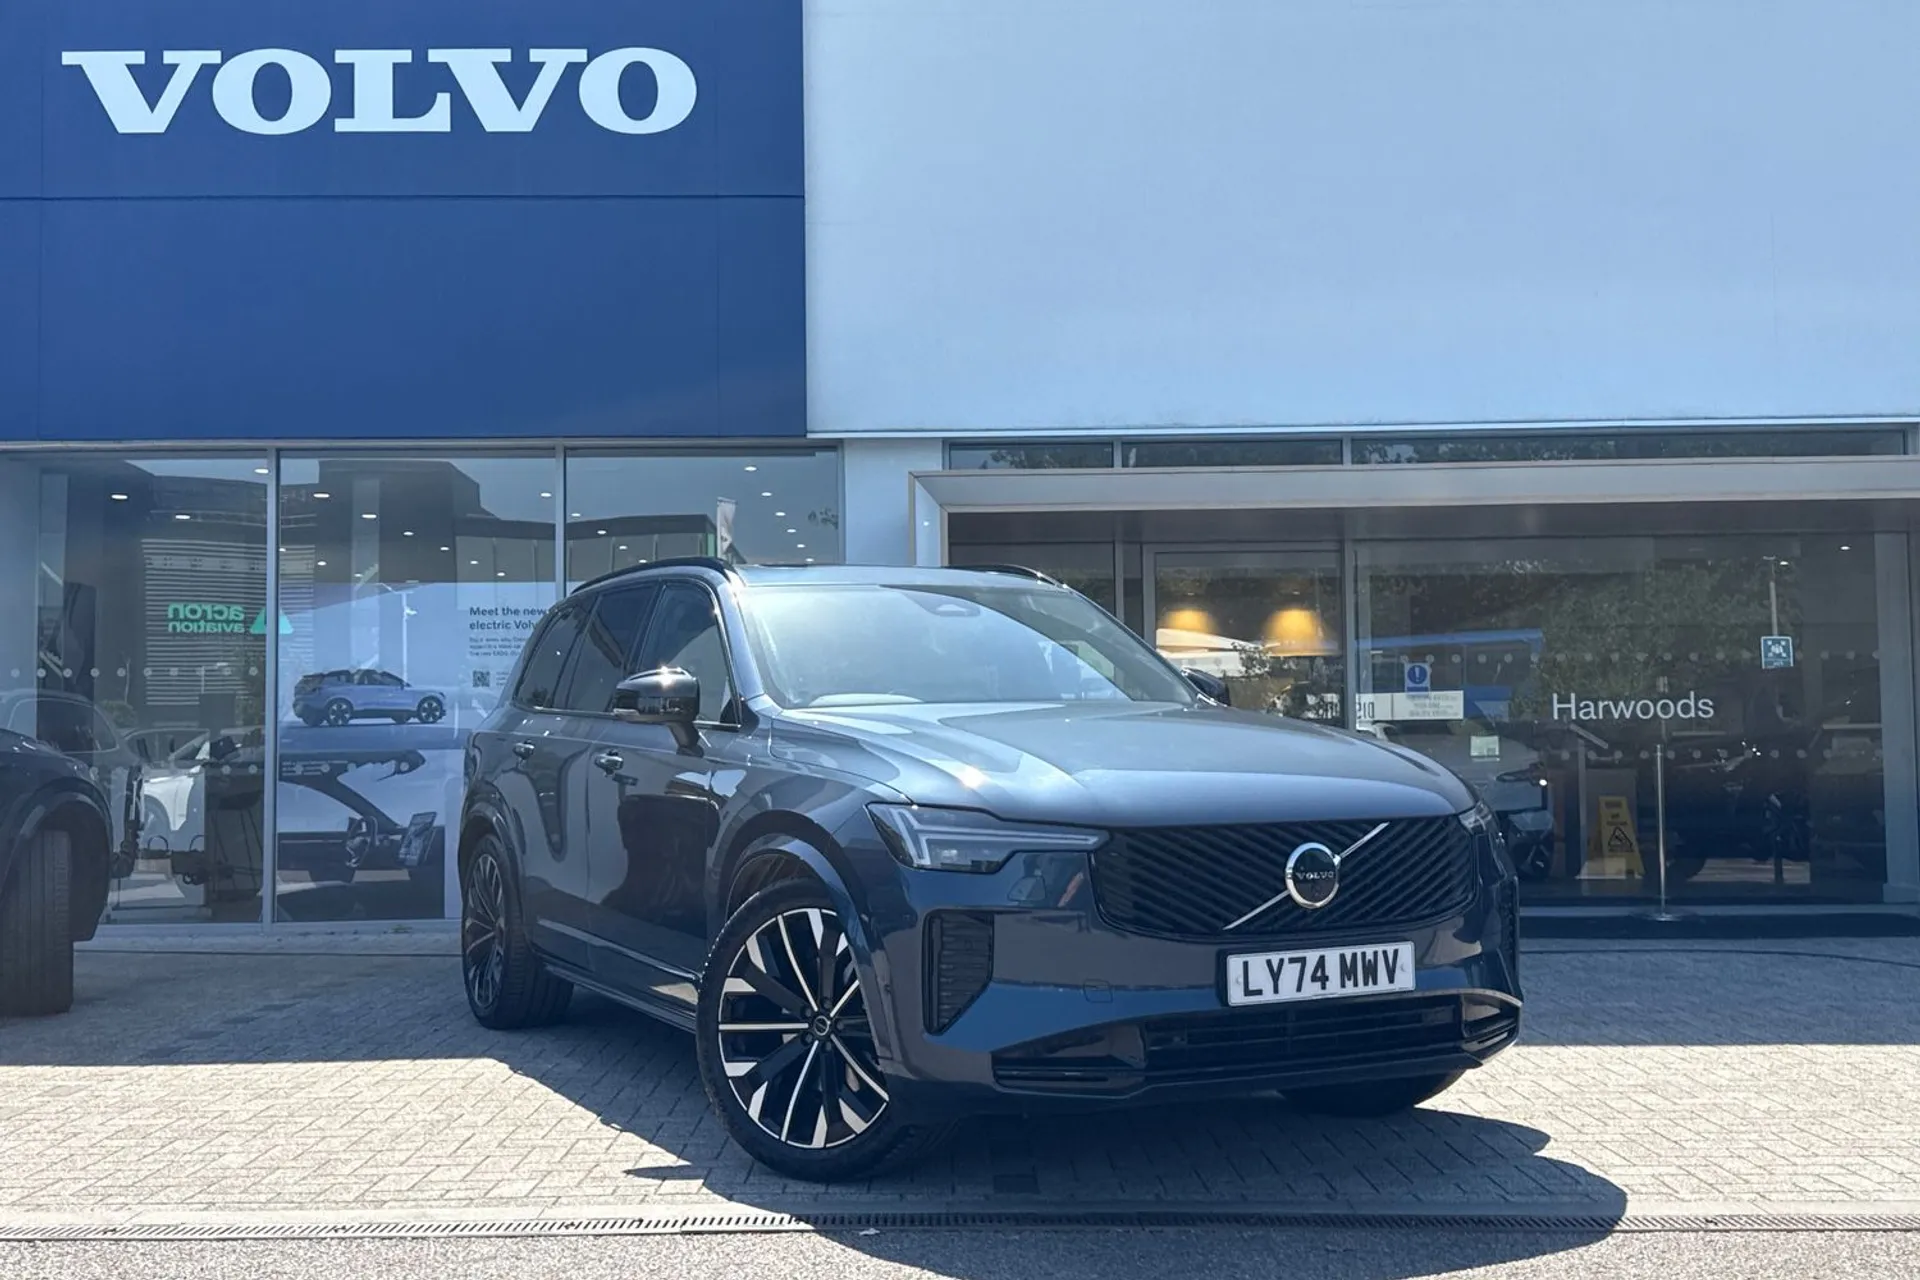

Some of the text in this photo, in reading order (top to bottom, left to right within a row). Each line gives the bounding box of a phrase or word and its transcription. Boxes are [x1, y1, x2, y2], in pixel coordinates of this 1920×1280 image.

[61, 47, 698, 135] VOLVO
[469, 607, 498, 616] Meet
[502, 607, 520, 616] the
[469, 620, 537, 630] electric Volv
[1552, 691, 1714, 720] Harwoods
[1295, 871, 1334, 880] VOLVO
[1242, 948, 1399, 997] LY74 MWV
